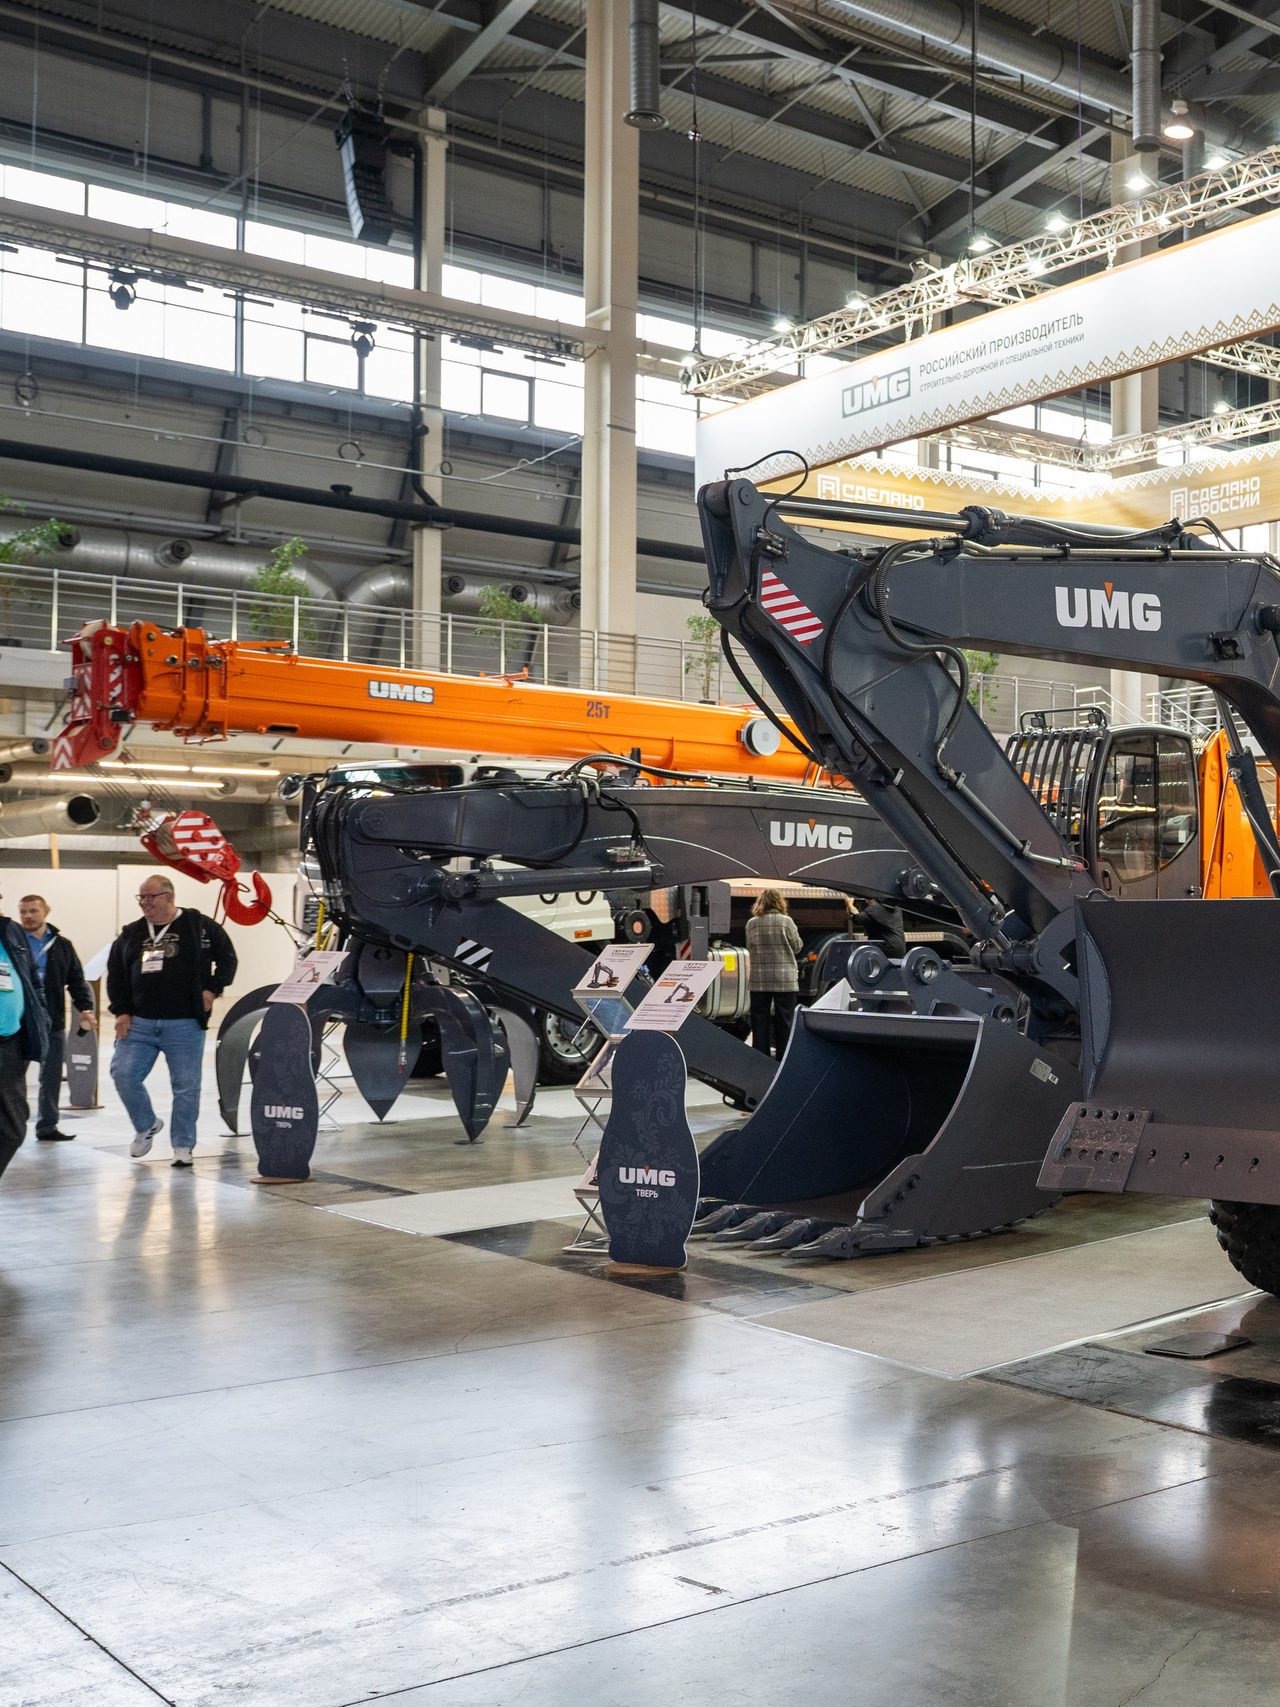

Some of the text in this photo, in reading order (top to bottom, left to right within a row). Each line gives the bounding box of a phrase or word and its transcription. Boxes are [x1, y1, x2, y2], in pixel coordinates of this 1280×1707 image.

[920, 312, 1084, 377] РОССИЙСКИЙ ПРОИЗВОДИТЕЛЬ
[919, 358, 999, 393] СТРОИТЕЛЬНО-ДОРОЖНОЙ
[1005, 342, 1053, 365] СПЕЦИАЛЬНОЙ
[1054, 333, 1085, 351] ТЕХНИКИ
[843, 369, 911, 417] UMG
[842, 483, 925, 511] СДЕЛАНО
[1190, 476, 1261, 504] СДЕЛАНО
[1200, 491, 1261, 517] РОССИИ
[1054, 584, 1162, 632] UMG
[369, 680, 434, 704] UMG
[769, 820, 853, 851] UMG
[263, 1104, 305, 1120] UMG
[618, 1165, 676, 1187] UMG
[635, 1188, 659, 1198] ТВЕРЬ
